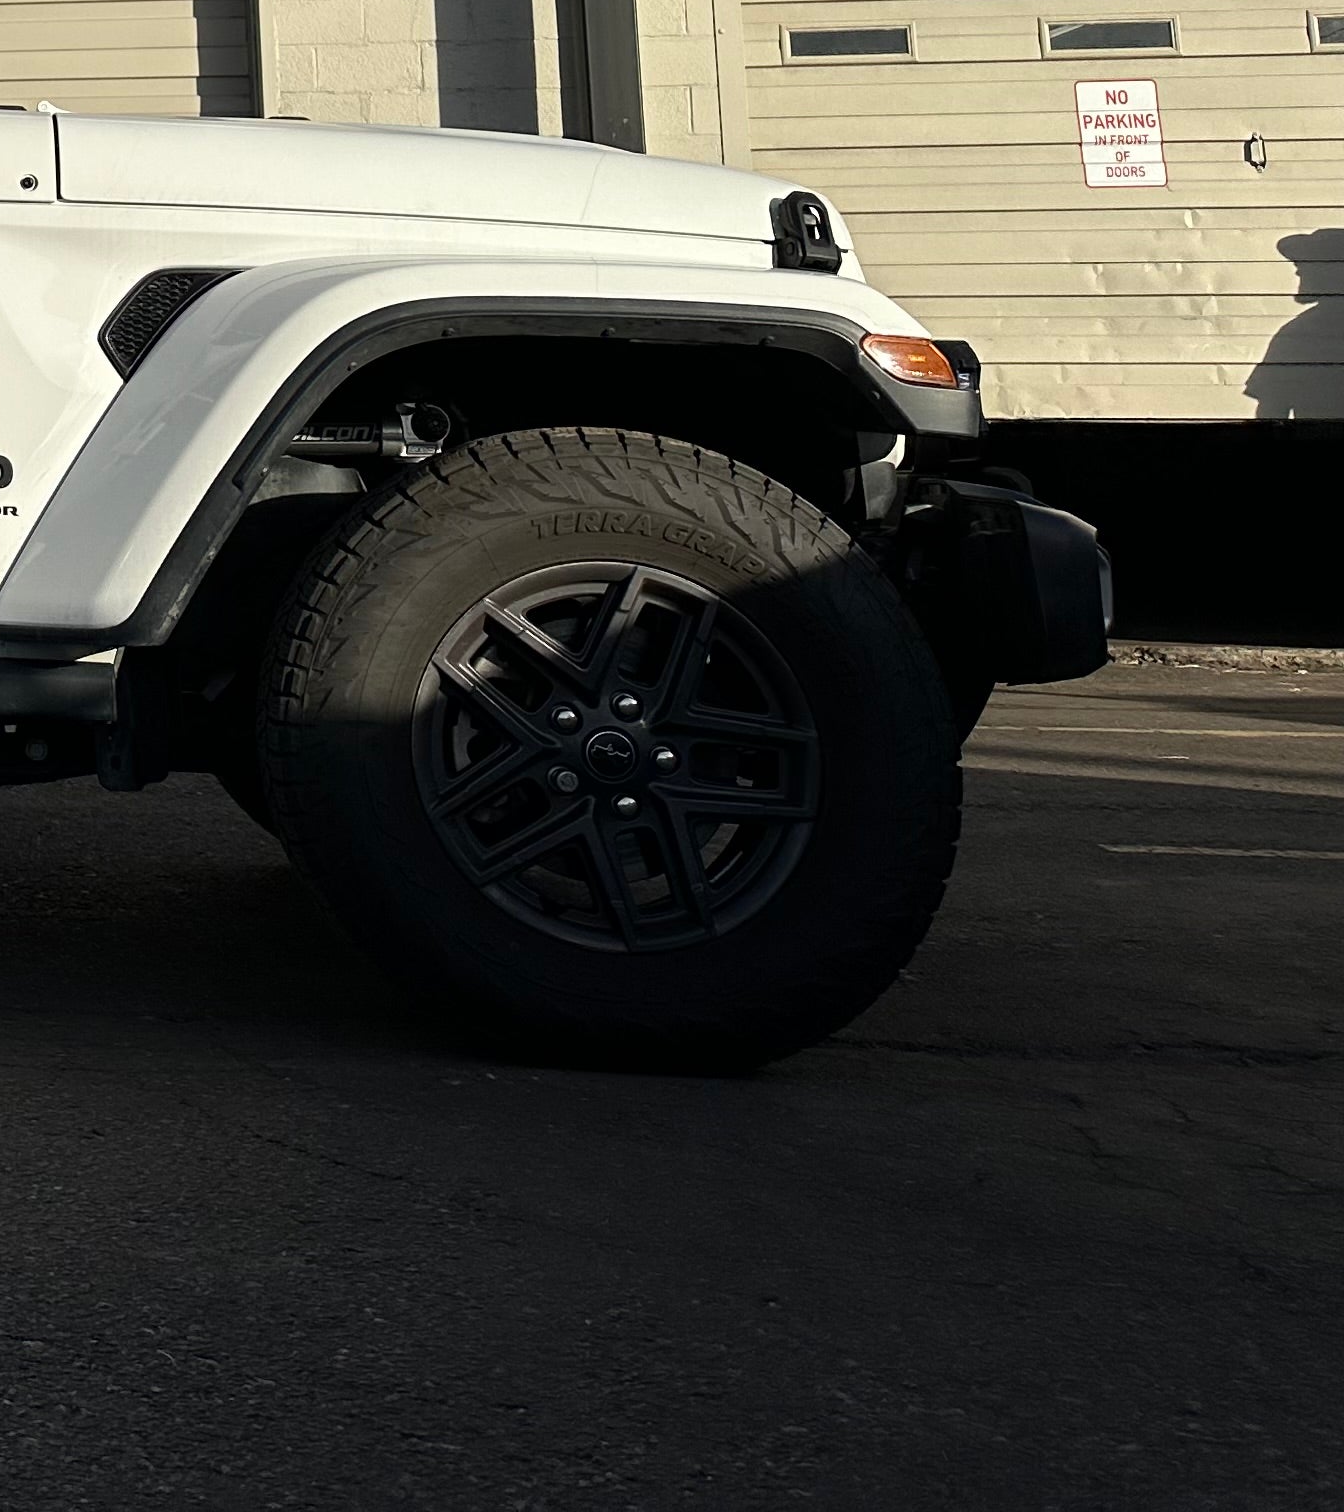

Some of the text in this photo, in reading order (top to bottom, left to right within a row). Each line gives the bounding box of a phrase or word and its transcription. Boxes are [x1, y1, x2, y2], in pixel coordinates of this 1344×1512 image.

[1105, 90, 1128, 105] NO
[1083, 113, 1157, 129] PARKING
[1094, 134, 1149, 146] IN FRONT
[1115, 151, 1130, 162] OF
[1106, 166, 1146, 178] DOORS
[531, 510, 654, 539] TERRA
